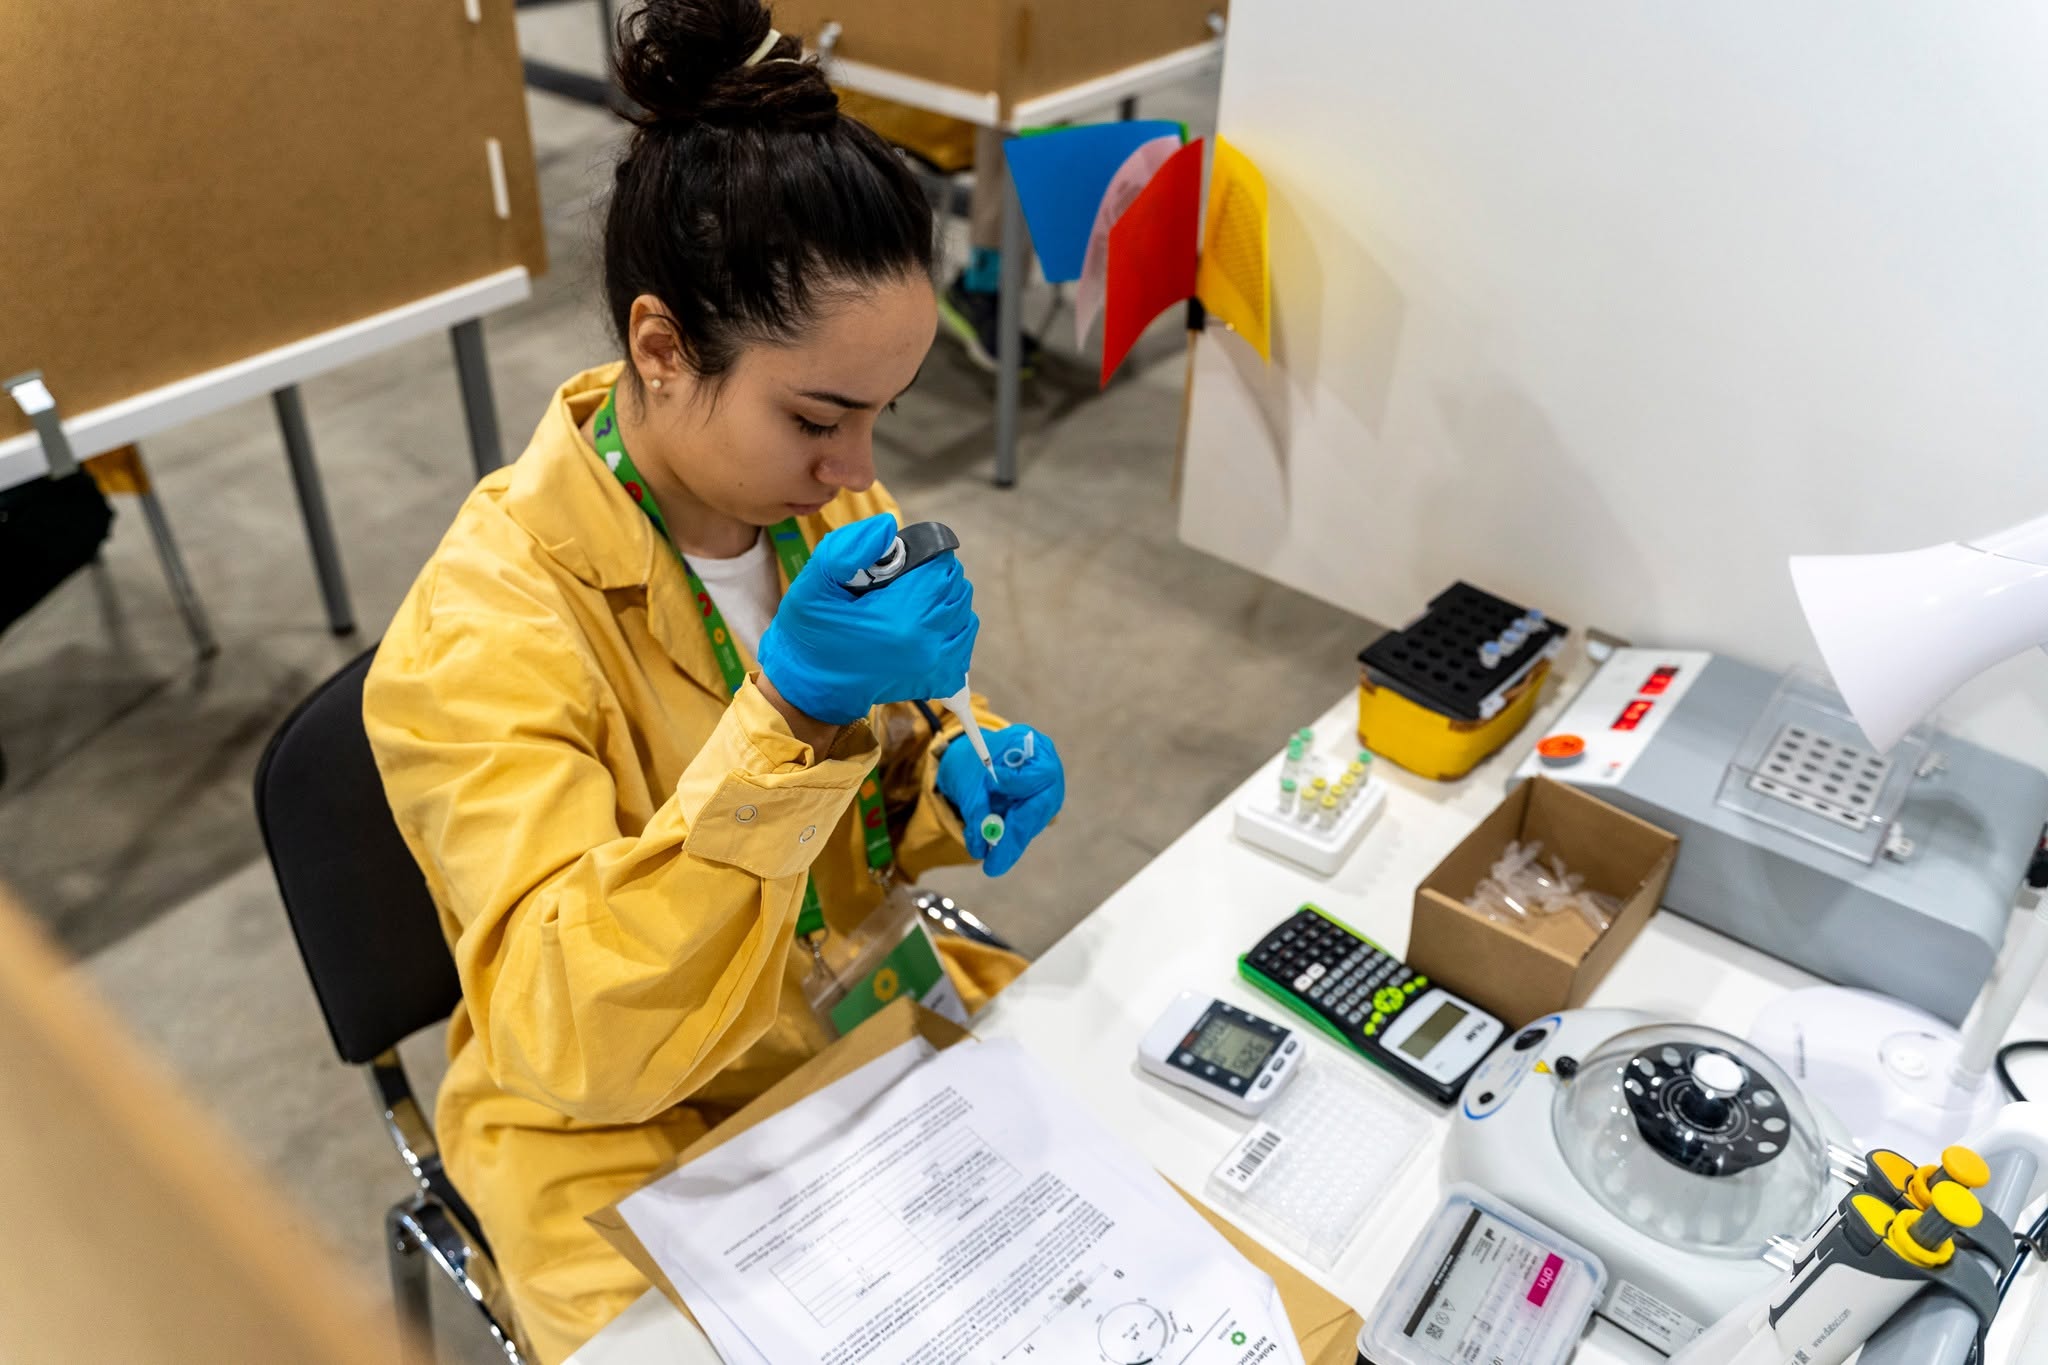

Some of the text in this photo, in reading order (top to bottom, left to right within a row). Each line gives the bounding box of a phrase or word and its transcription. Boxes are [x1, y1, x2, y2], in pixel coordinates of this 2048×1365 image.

[1112, 1267, 1125, 1281] B
[1536, 1266, 1554, 1289] ahn
[1022, 1342, 1034, 1354] M
[1253, 1335, 1268, 1351] and
